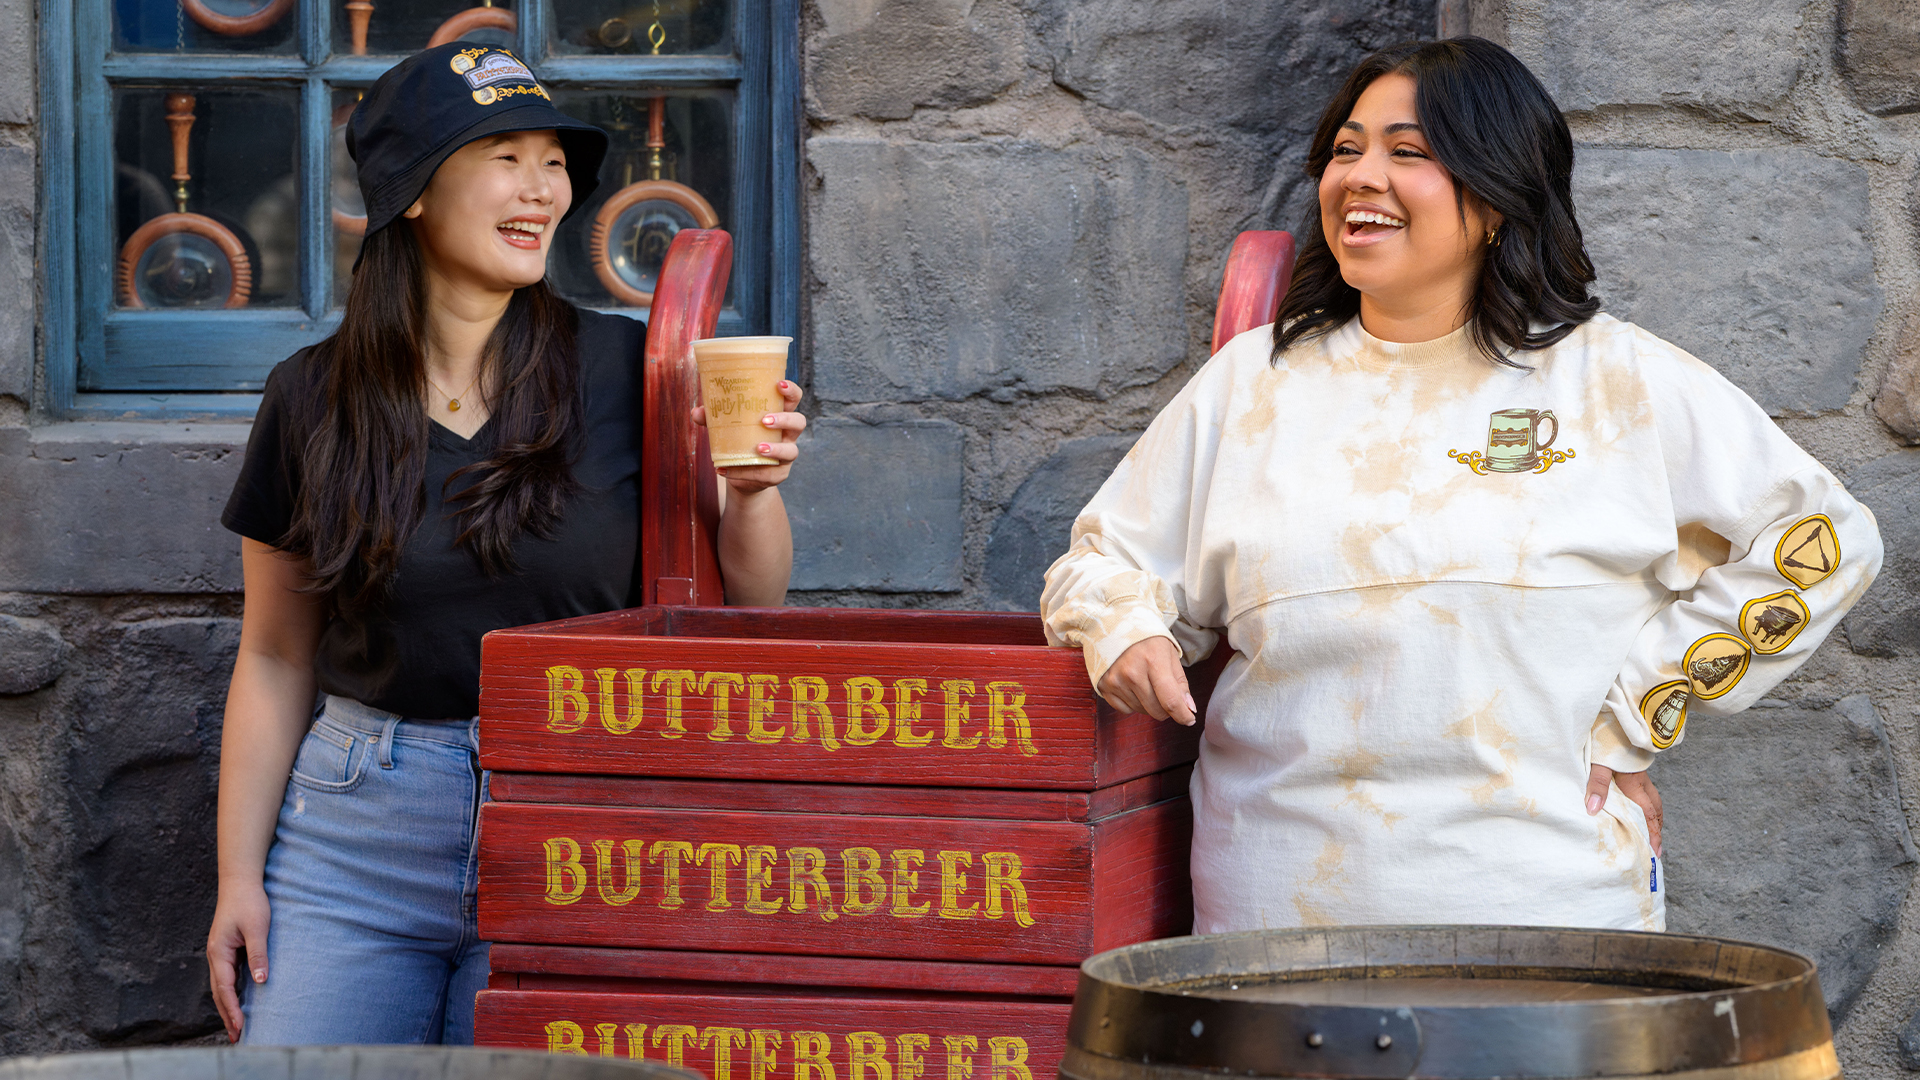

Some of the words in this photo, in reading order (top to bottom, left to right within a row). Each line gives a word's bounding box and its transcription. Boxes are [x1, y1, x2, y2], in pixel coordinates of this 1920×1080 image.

[710, 397, 736, 418] Harry
[737, 393, 769, 417] Potter
[721, 384, 749, 395] WORLD
[545, 665, 1038, 757] BUTTERBEER
[543, 837, 1035, 928] BUTTERBEER
